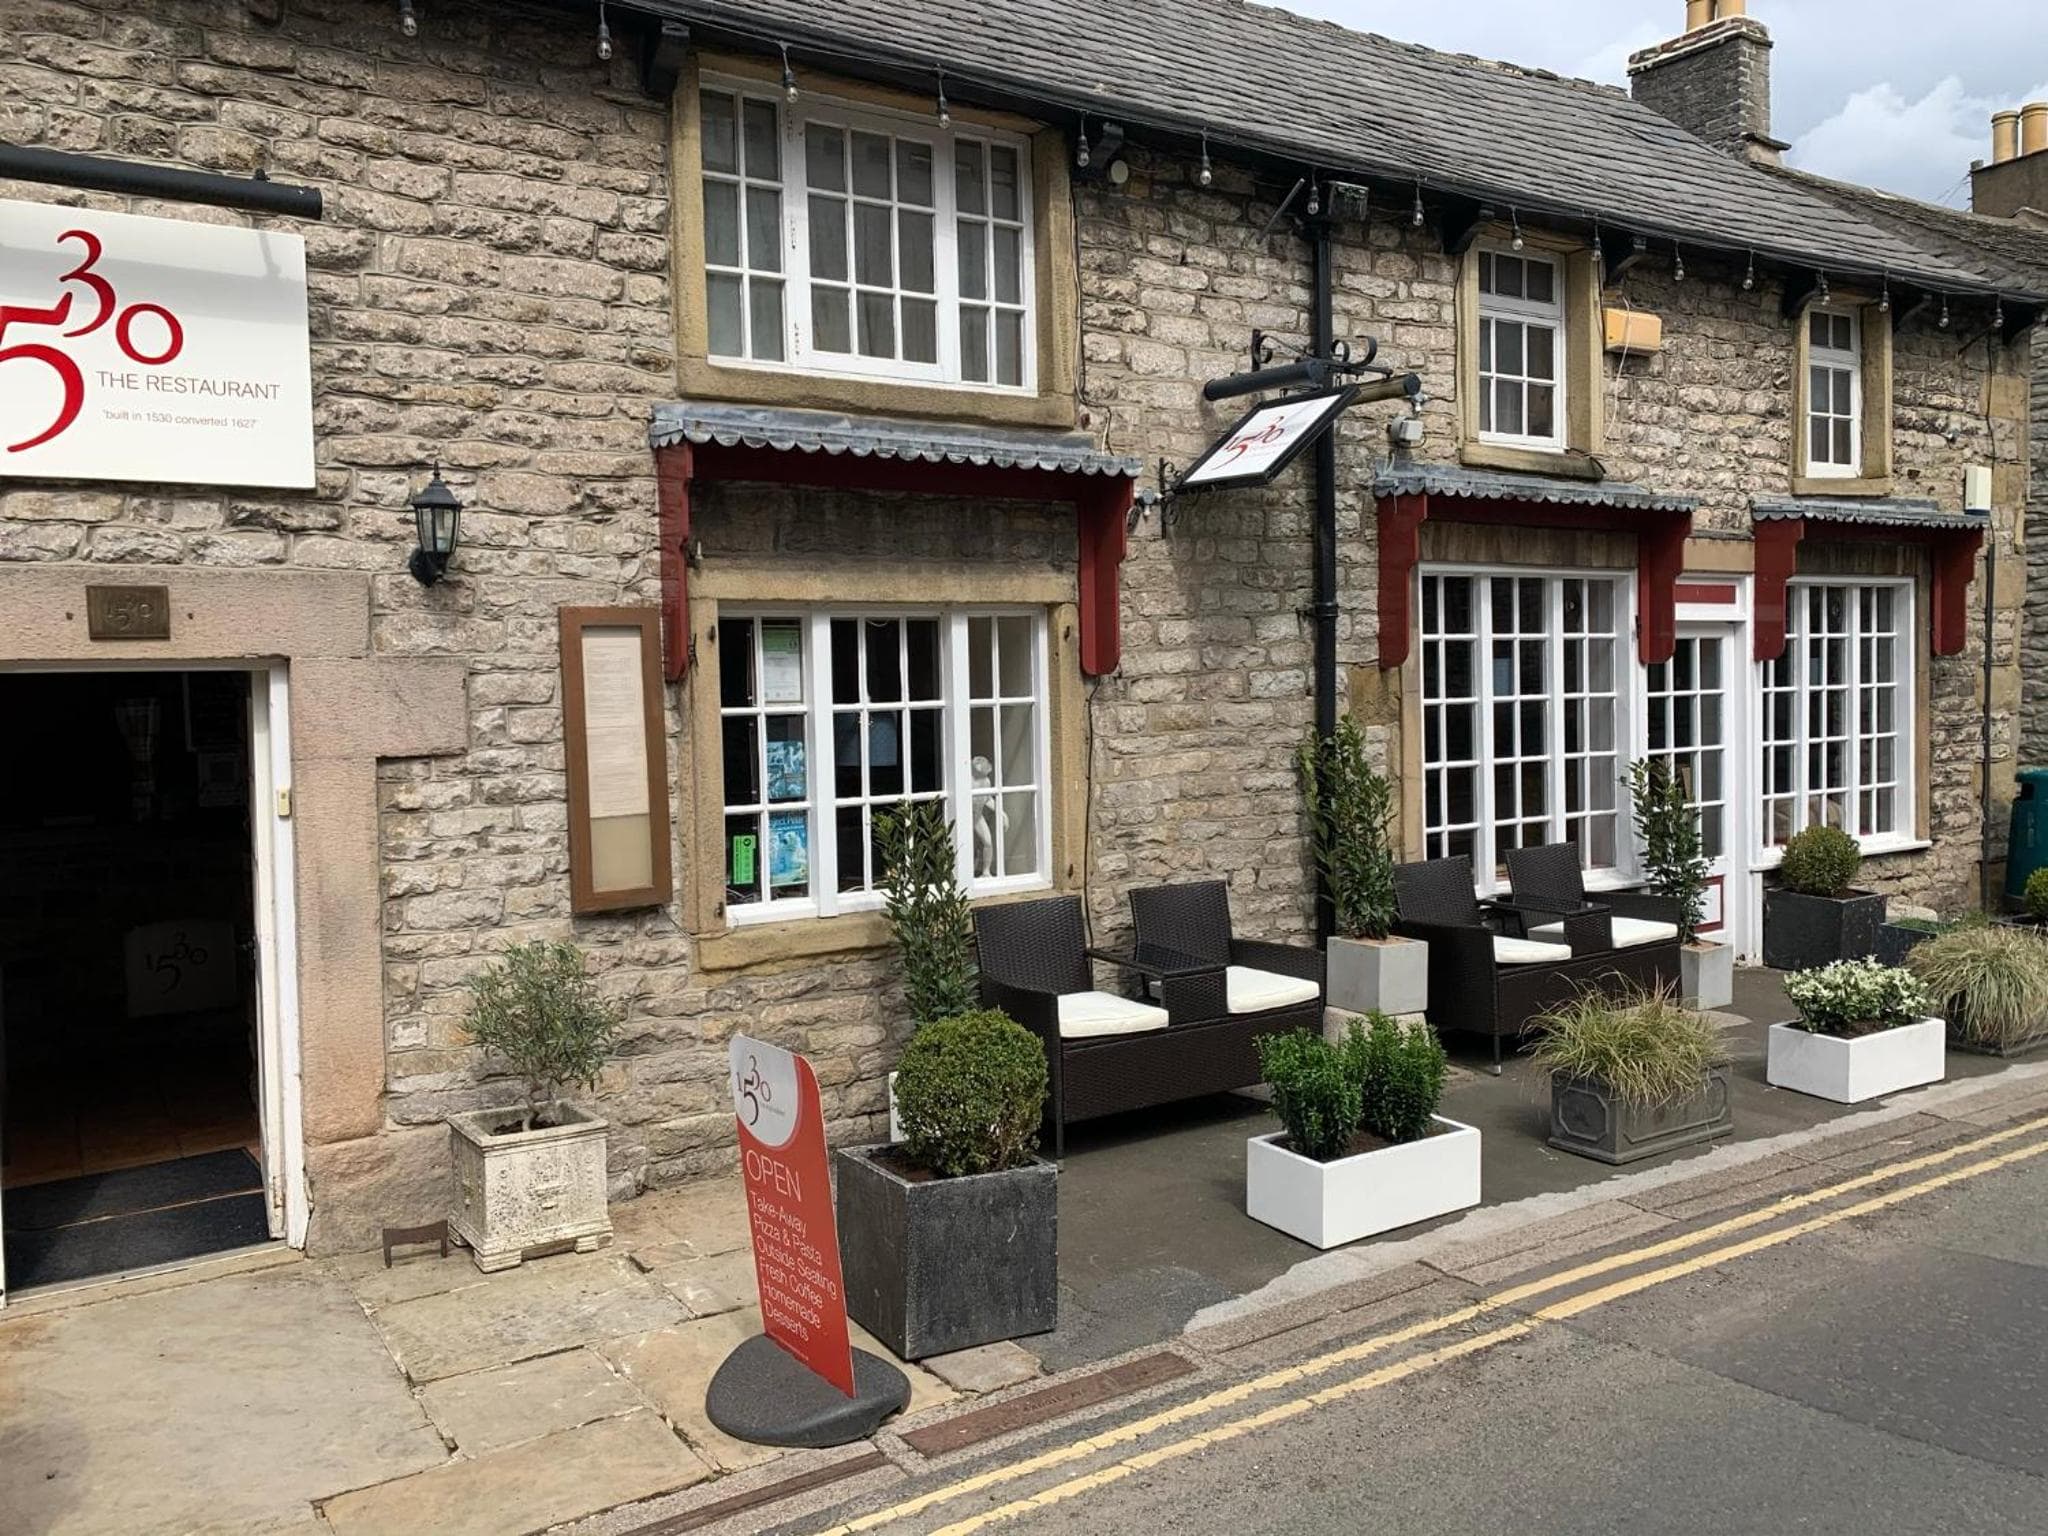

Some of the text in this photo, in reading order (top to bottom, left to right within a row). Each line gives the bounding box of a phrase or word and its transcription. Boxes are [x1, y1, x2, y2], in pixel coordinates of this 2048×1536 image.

[96, 371, 281, 400] THE RESTAURANT
[132, 411, 142, 422] in
[146, 412, 173, 424] 1530
[175, 415, 228, 427] converted
[736, 1054, 772, 1126] 1530
[746, 1149, 801, 1202] OPEN
[750, 1190, 807, 1238] Take-Away
[754, 1212, 823, 1266] Pizza & Pasta
[756, 1234, 838, 1300] Outside Seating
[758, 1255, 824, 1310] Fresh Coffee
[761, 1277, 822, 1329] Homemade
[764, 1299, 810, 1342] Desserts
